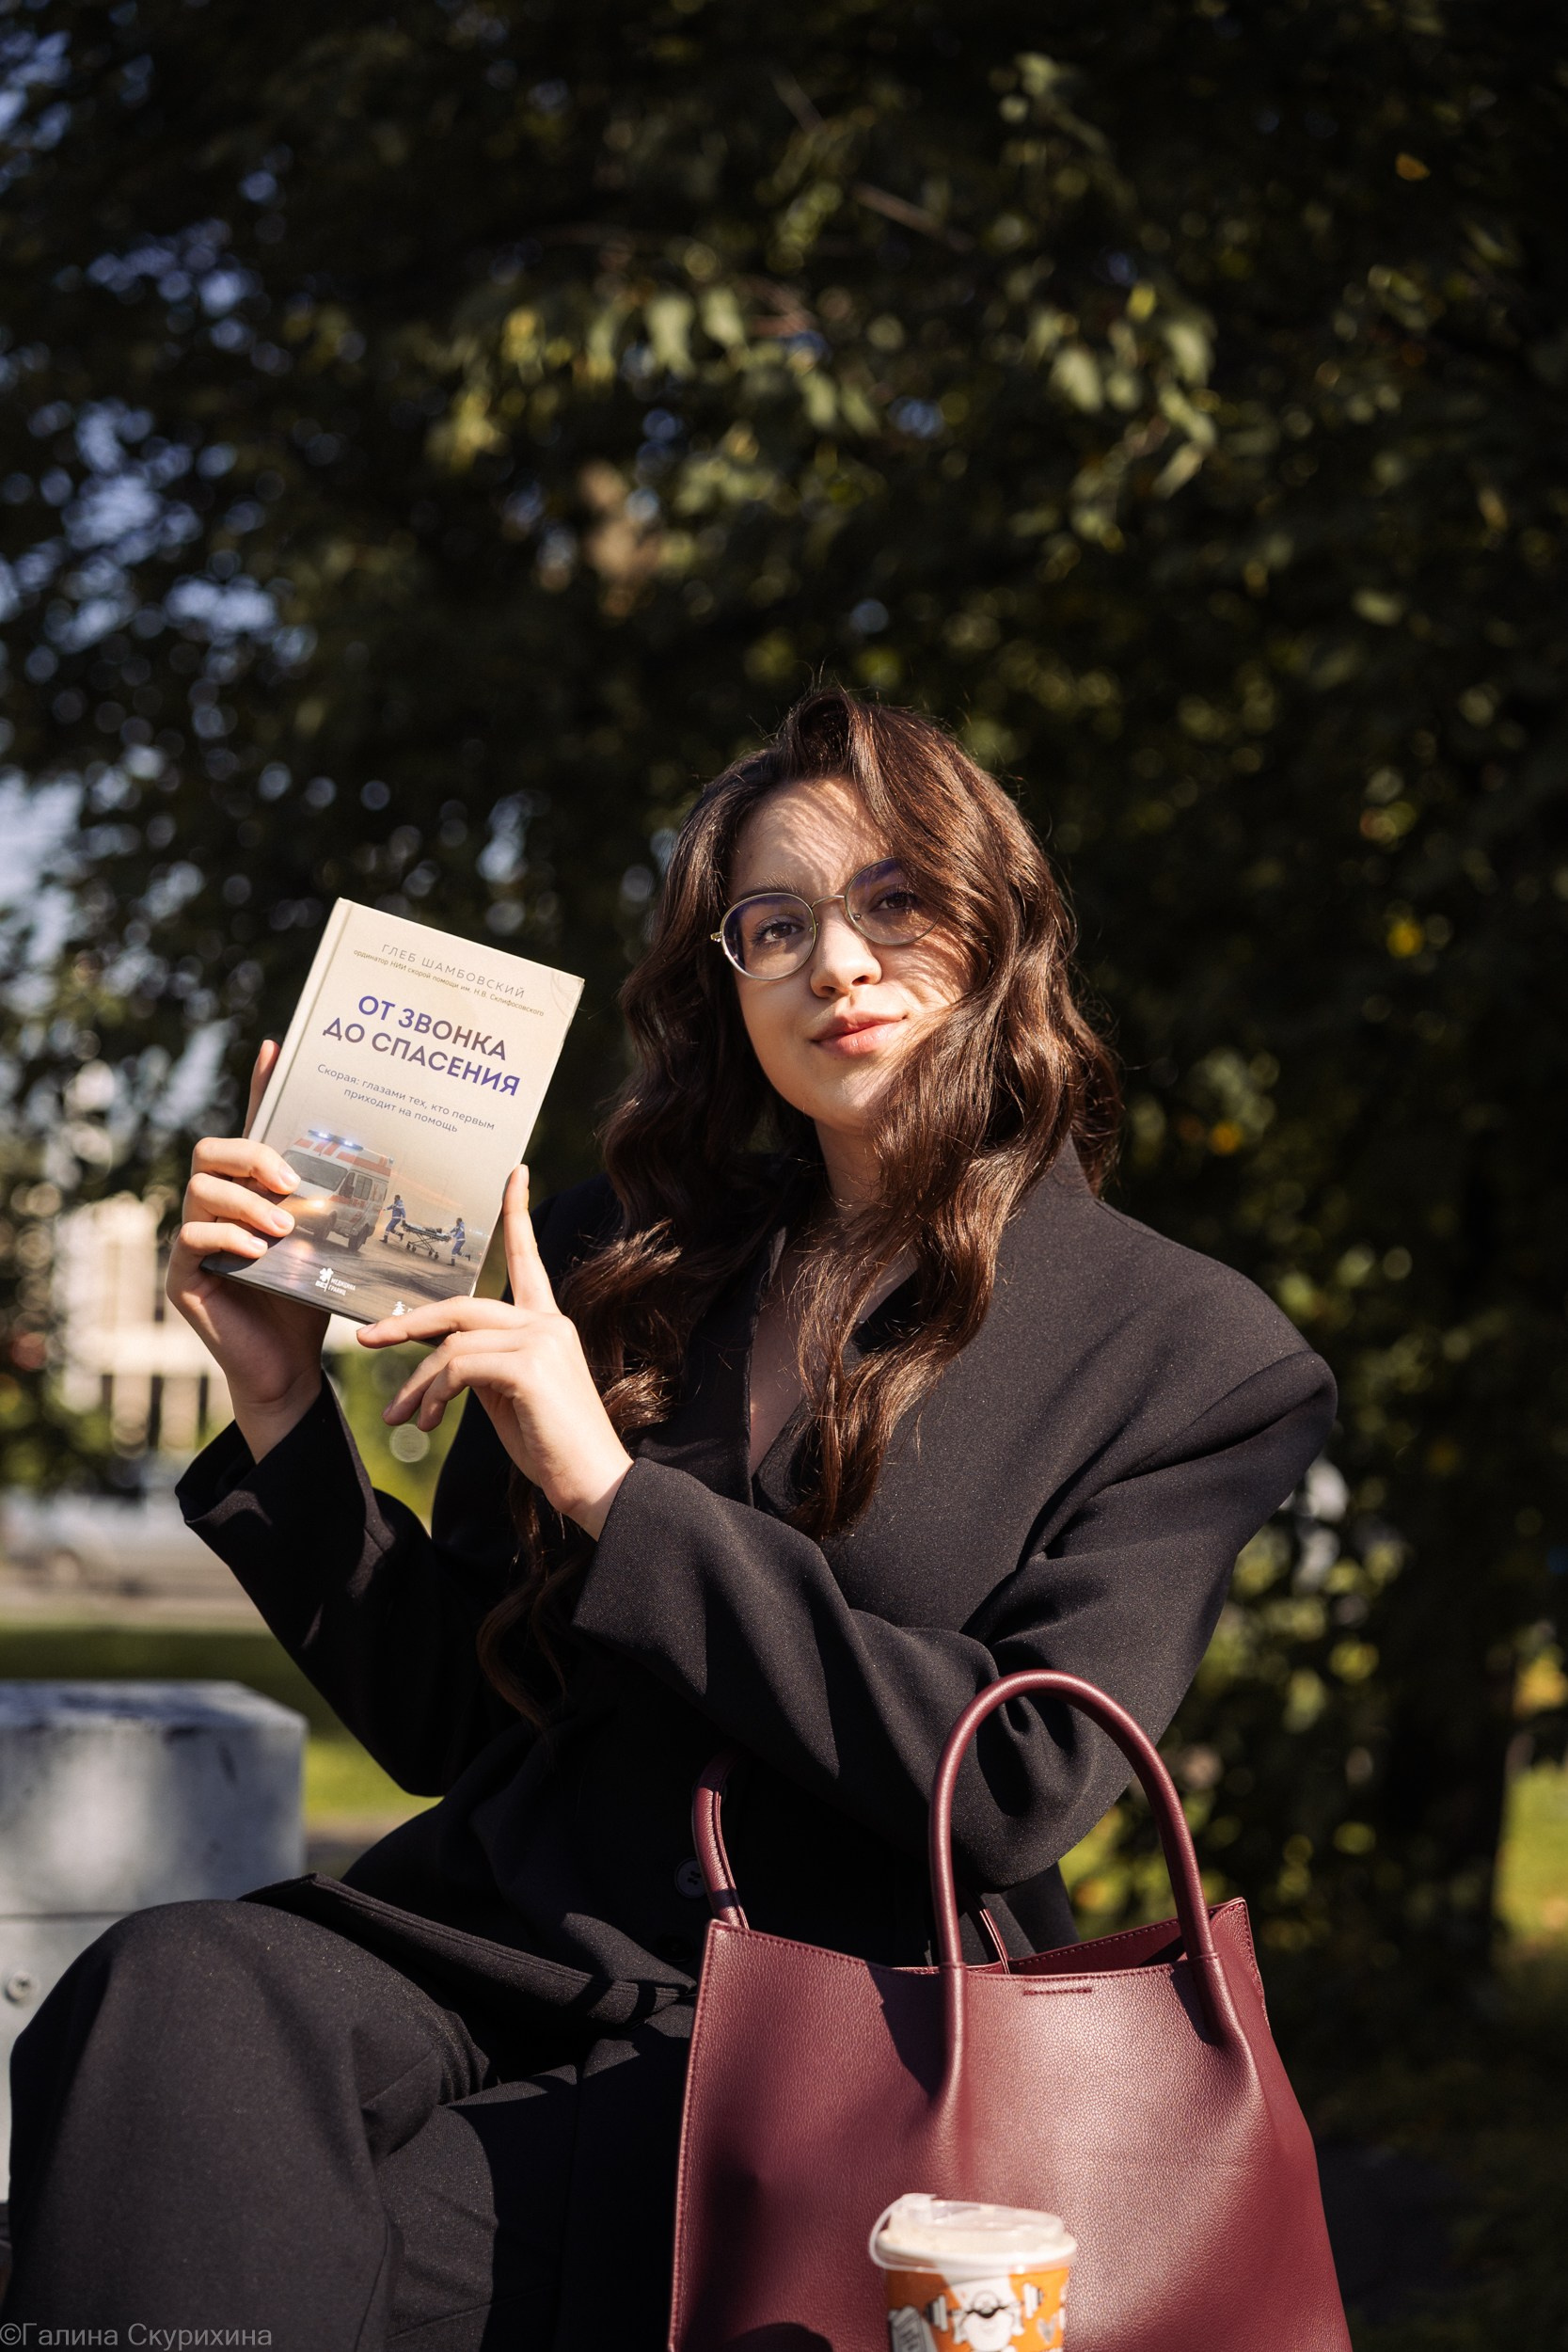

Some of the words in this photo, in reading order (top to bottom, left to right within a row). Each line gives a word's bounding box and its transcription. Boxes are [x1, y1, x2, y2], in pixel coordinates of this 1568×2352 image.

[353, 949, 388, 965] ординатор
[390, 961, 406, 971] НИИ
[407, 967, 431, 979] скорой
[432, 976, 459, 989] помощи
[489, 993, 545, 1017] Склифосовского
[381, 944, 417, 962] ГЛЕБ
[421, 957, 526, 998] ШАМБОВСКИЙ
[323, 1017, 365, 1043] ДО
[372, 1032, 521, 1097] СПАСЕНИЯ
[358, 995, 396, 1021] ОТ
[398, 1008, 507, 1061] ЗВОНКА
[317, 1063, 360, 1086] Скорая:
[362, 1080, 406, 1101] глазами
[408, 1096, 428, 1109] тех,
[431, 1104, 450, 1115] кто
[451, 1111, 495, 1131] первым
[343, 1089, 397, 1112] приходит
[399, 1107, 412, 1118] на
[414, 1113, 458, 1133] помощь
